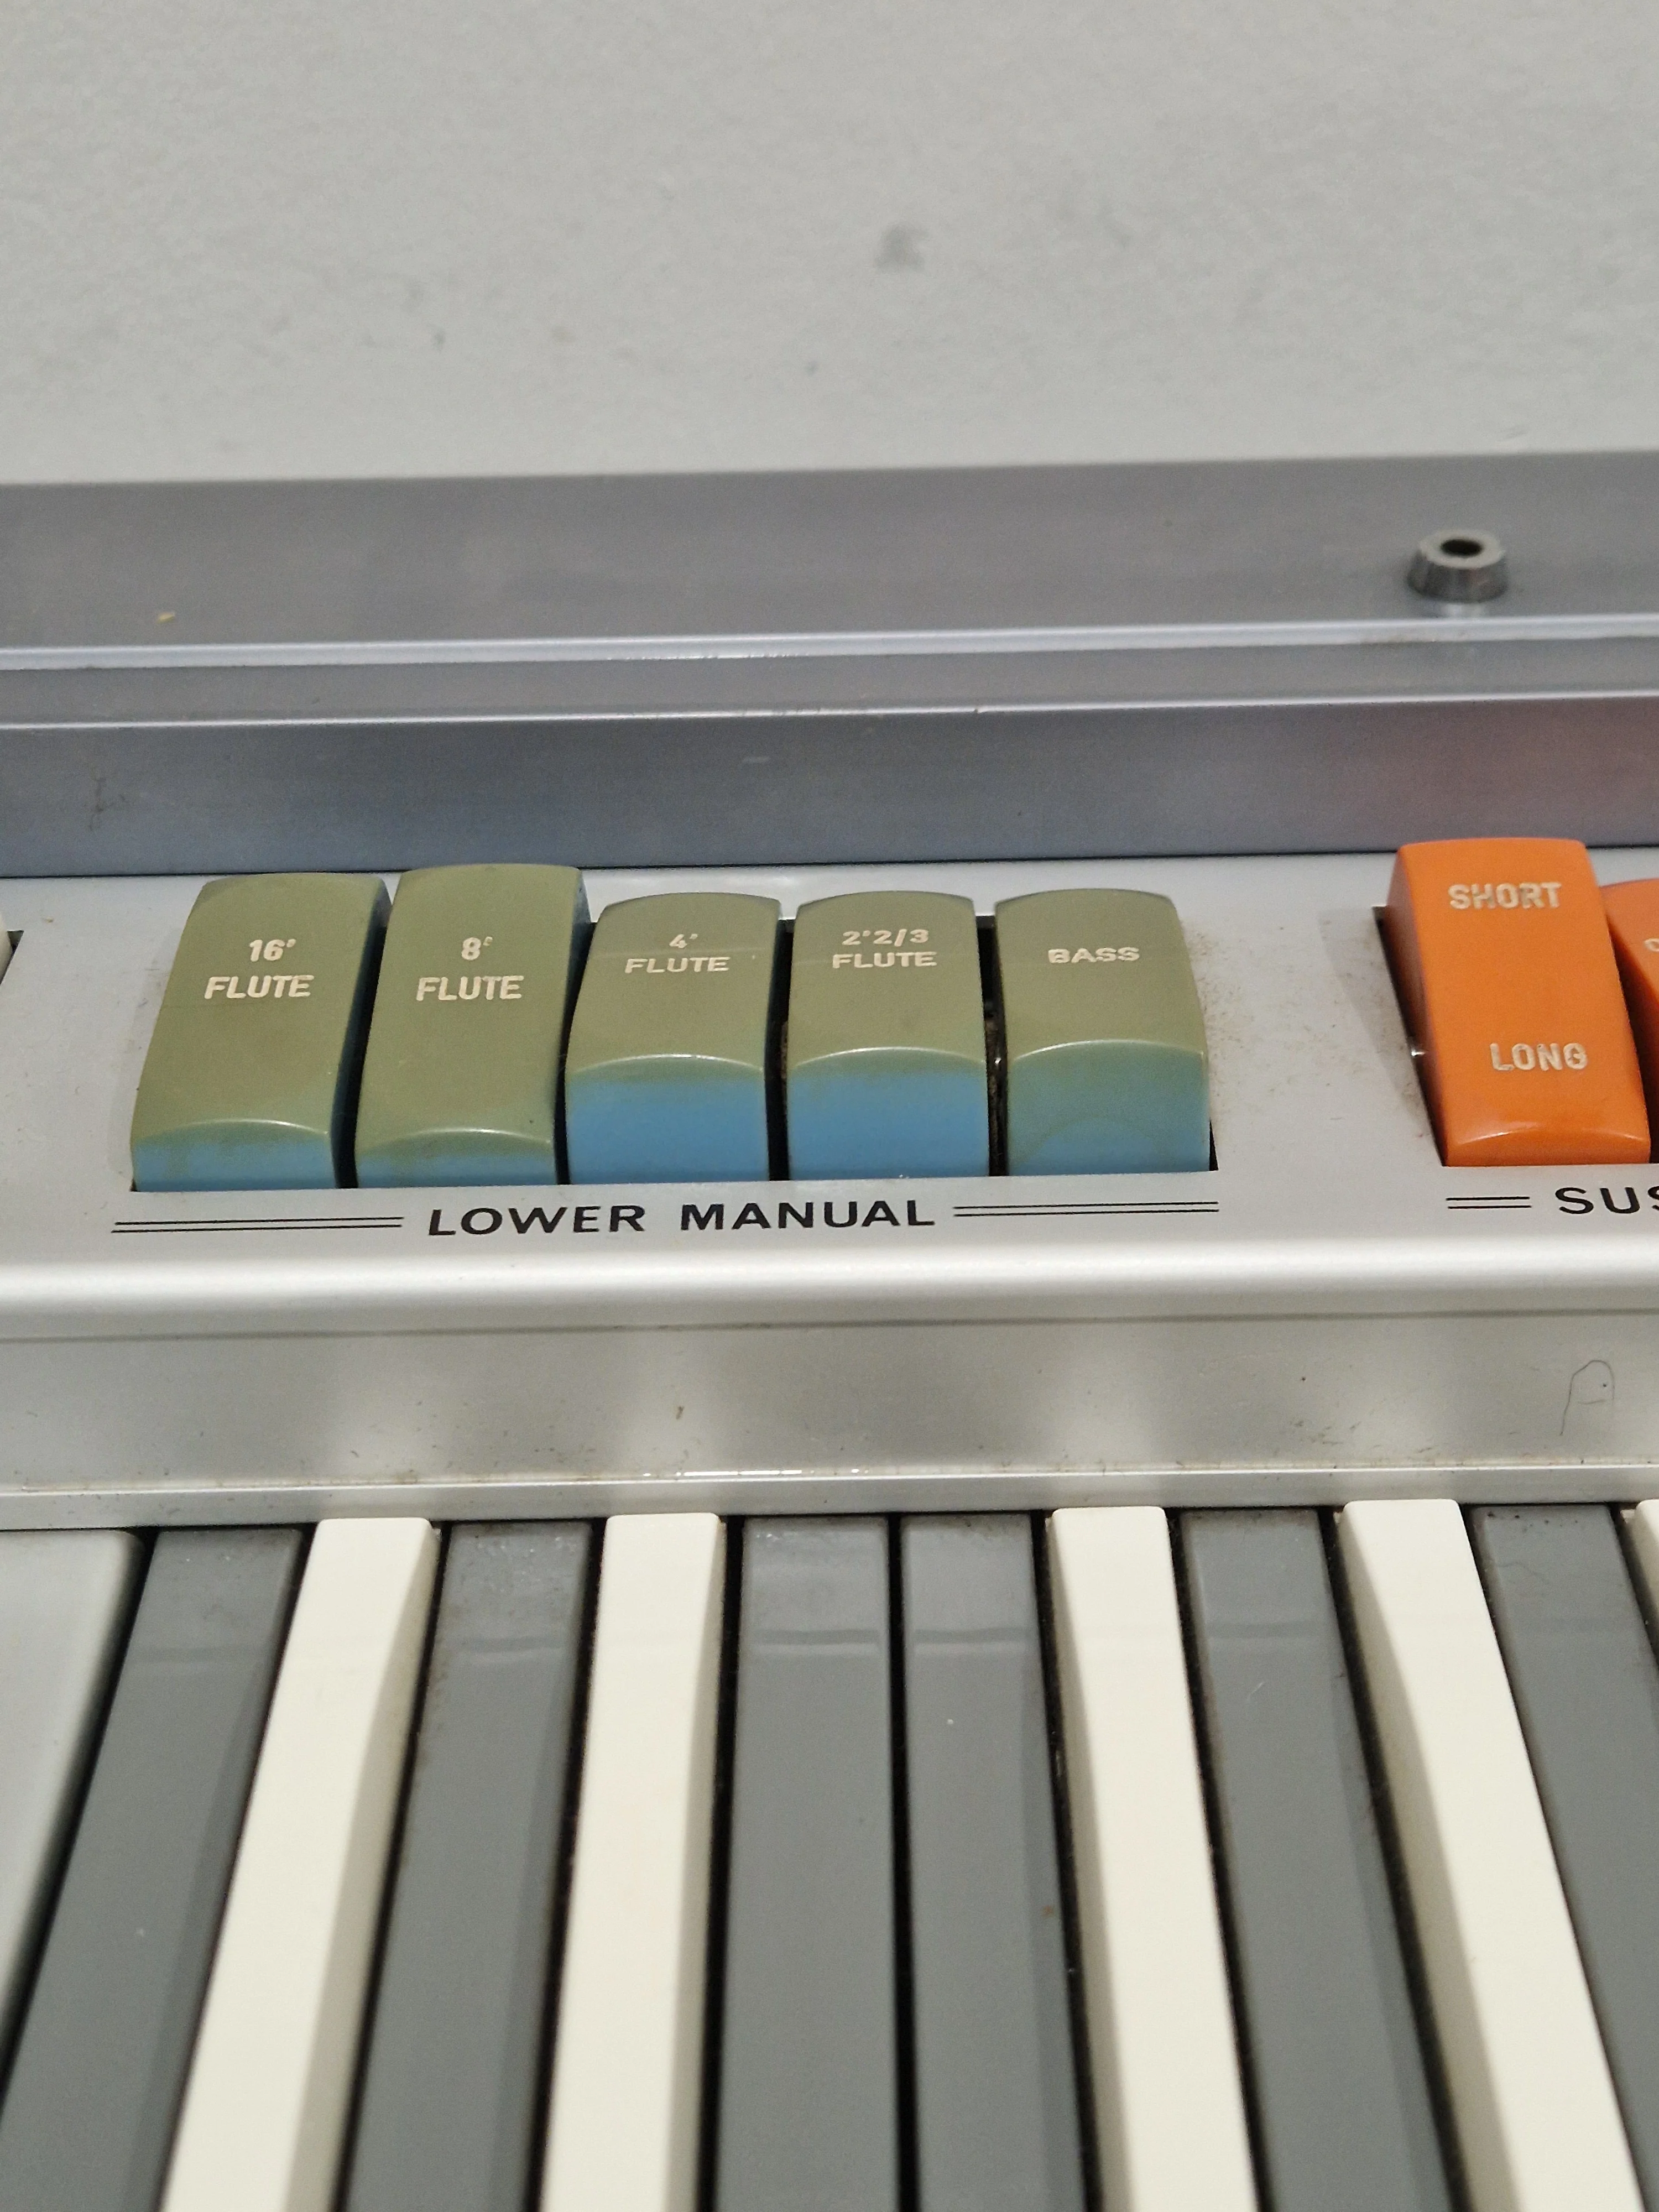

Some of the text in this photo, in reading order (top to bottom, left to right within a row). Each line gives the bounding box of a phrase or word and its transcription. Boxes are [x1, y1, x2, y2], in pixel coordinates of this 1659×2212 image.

[1448, 881, 1562, 909] SHORT
[624, 957, 731, 973] FLUTE
[832, 951, 937, 969] FLUTE
[1048, 946, 1140, 964] BASS
[204, 975, 315, 999] FLUTE
[416, 975, 525, 1001] FLUTE
[1489, 1042, 1588, 1071] LONG
[428, 1199, 936, 1237] LOWER MANUAL
